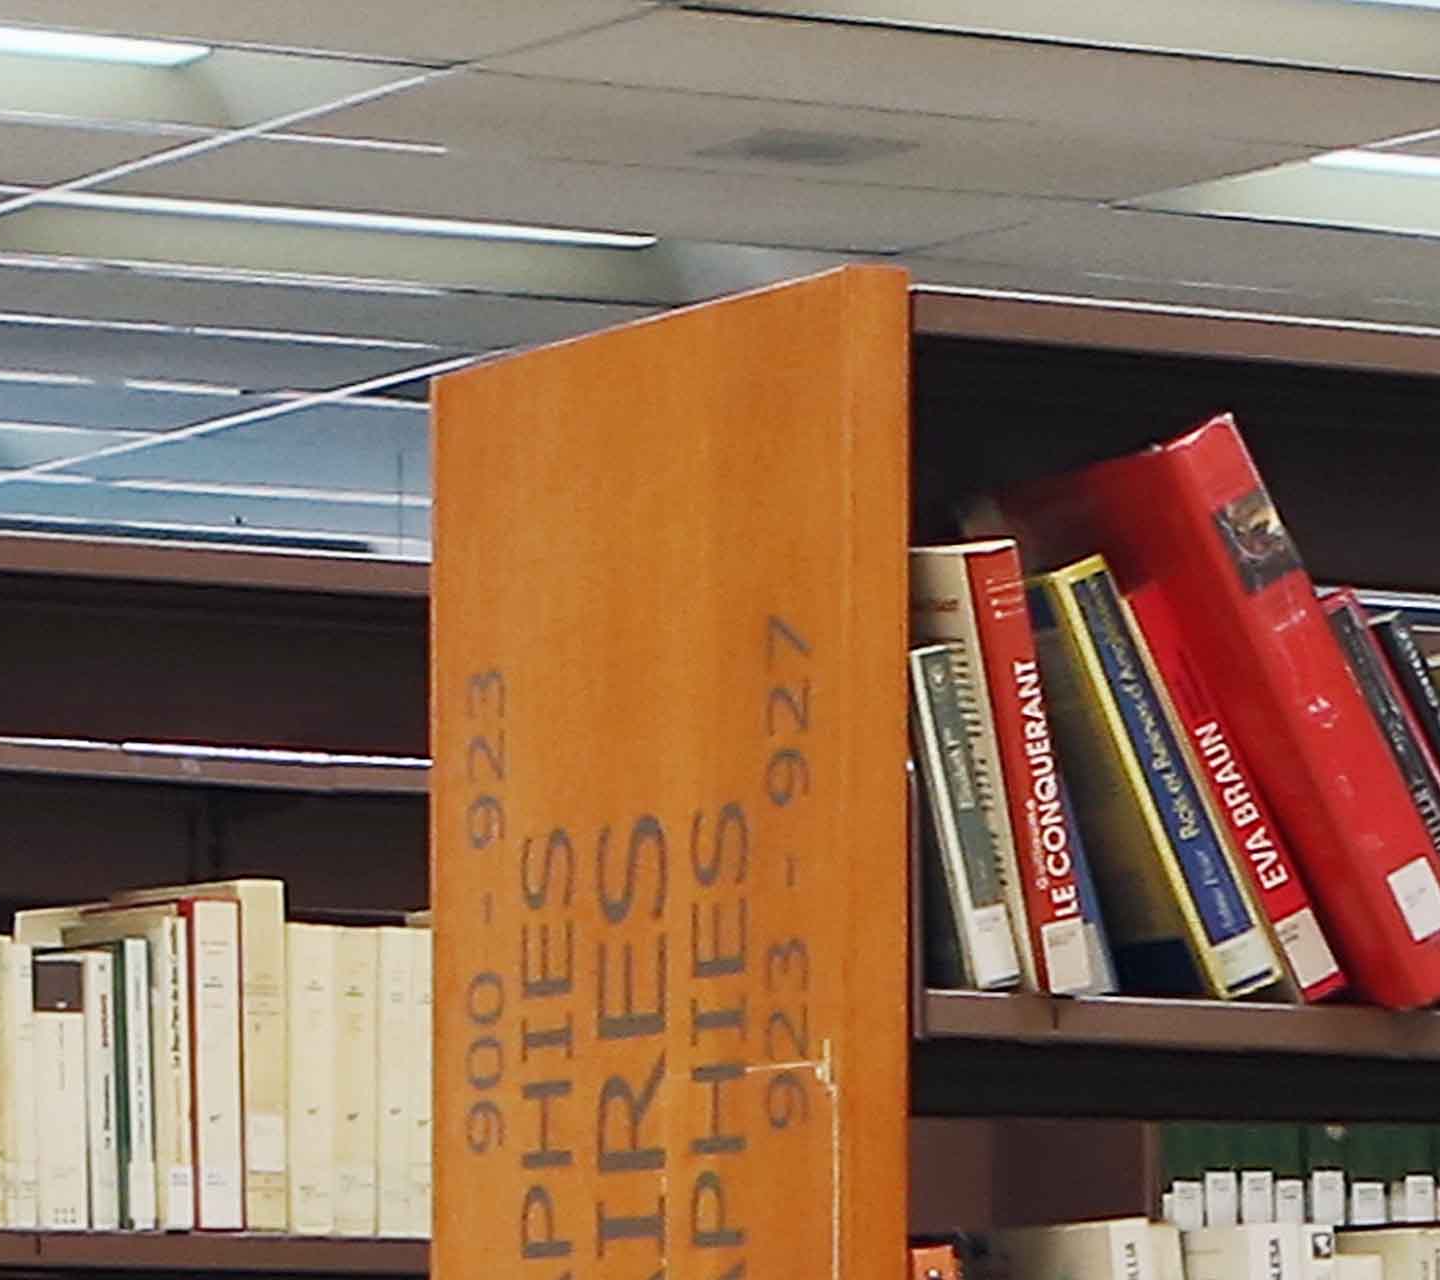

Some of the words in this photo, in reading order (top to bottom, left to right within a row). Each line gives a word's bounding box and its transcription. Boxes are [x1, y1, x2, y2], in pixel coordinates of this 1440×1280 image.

[465, 664, 504, 852] 923
[767, 614, 810, 808] 927
[1191, 719, 1259, 829] BRAUN
[1050, 884, 1079, 917] LE
[1240, 826, 1288, 890] EVA
[465, 969, 504, 1155] 900
[767, 936, 810, 1131] 923
